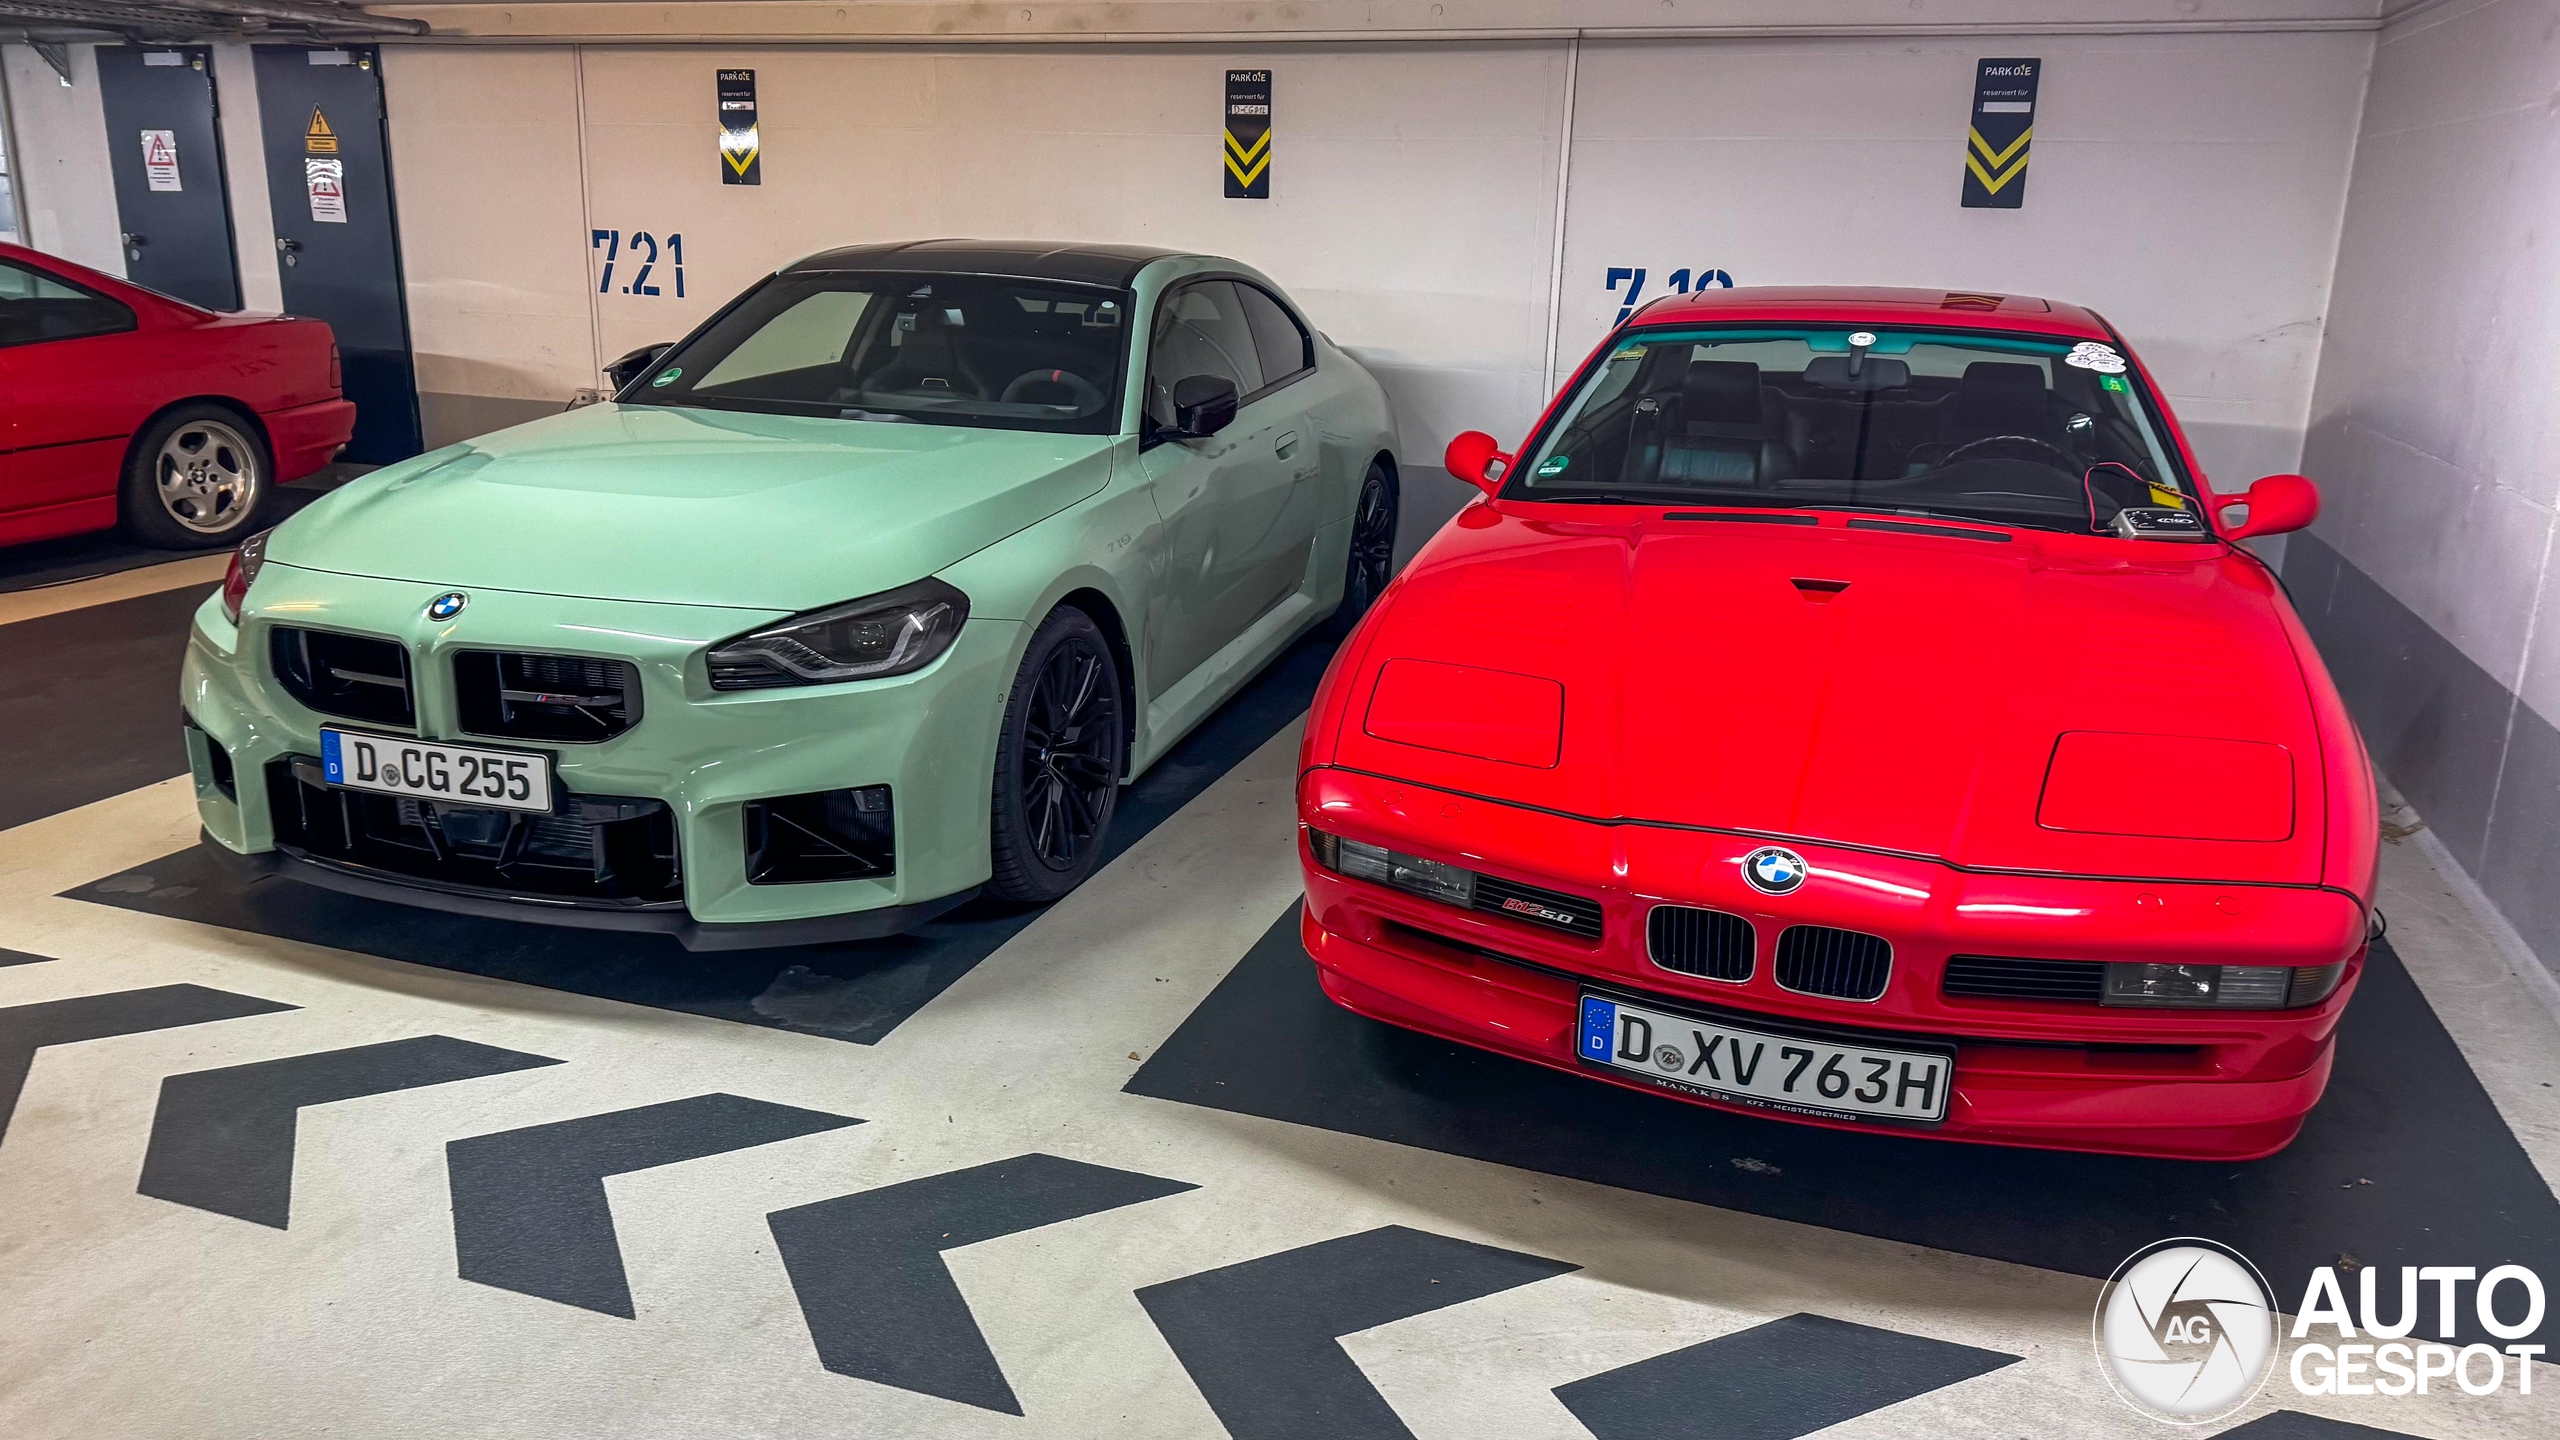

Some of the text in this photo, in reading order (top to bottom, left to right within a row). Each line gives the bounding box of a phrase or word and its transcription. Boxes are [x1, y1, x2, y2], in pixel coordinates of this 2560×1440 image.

[1985, 66, 2012, 76] PARK
[591, 229, 685, 298] 7.21
[329, 762, 338, 775] D
[354, 741, 377, 782] D
[401, 748, 451, 793] CG
[458, 755, 531, 801] 255
[1590, 1036, 1603, 1050] D
[1617, 1013, 1652, 1063] D
[1687, 1030, 1764, 1086] XV
[1781, 1047, 1939, 1110] 763H
[1746, 1099, 1765, 1108] KFZ
[1773, 1103, 1857, 1122] MEISTERBETRIEB
